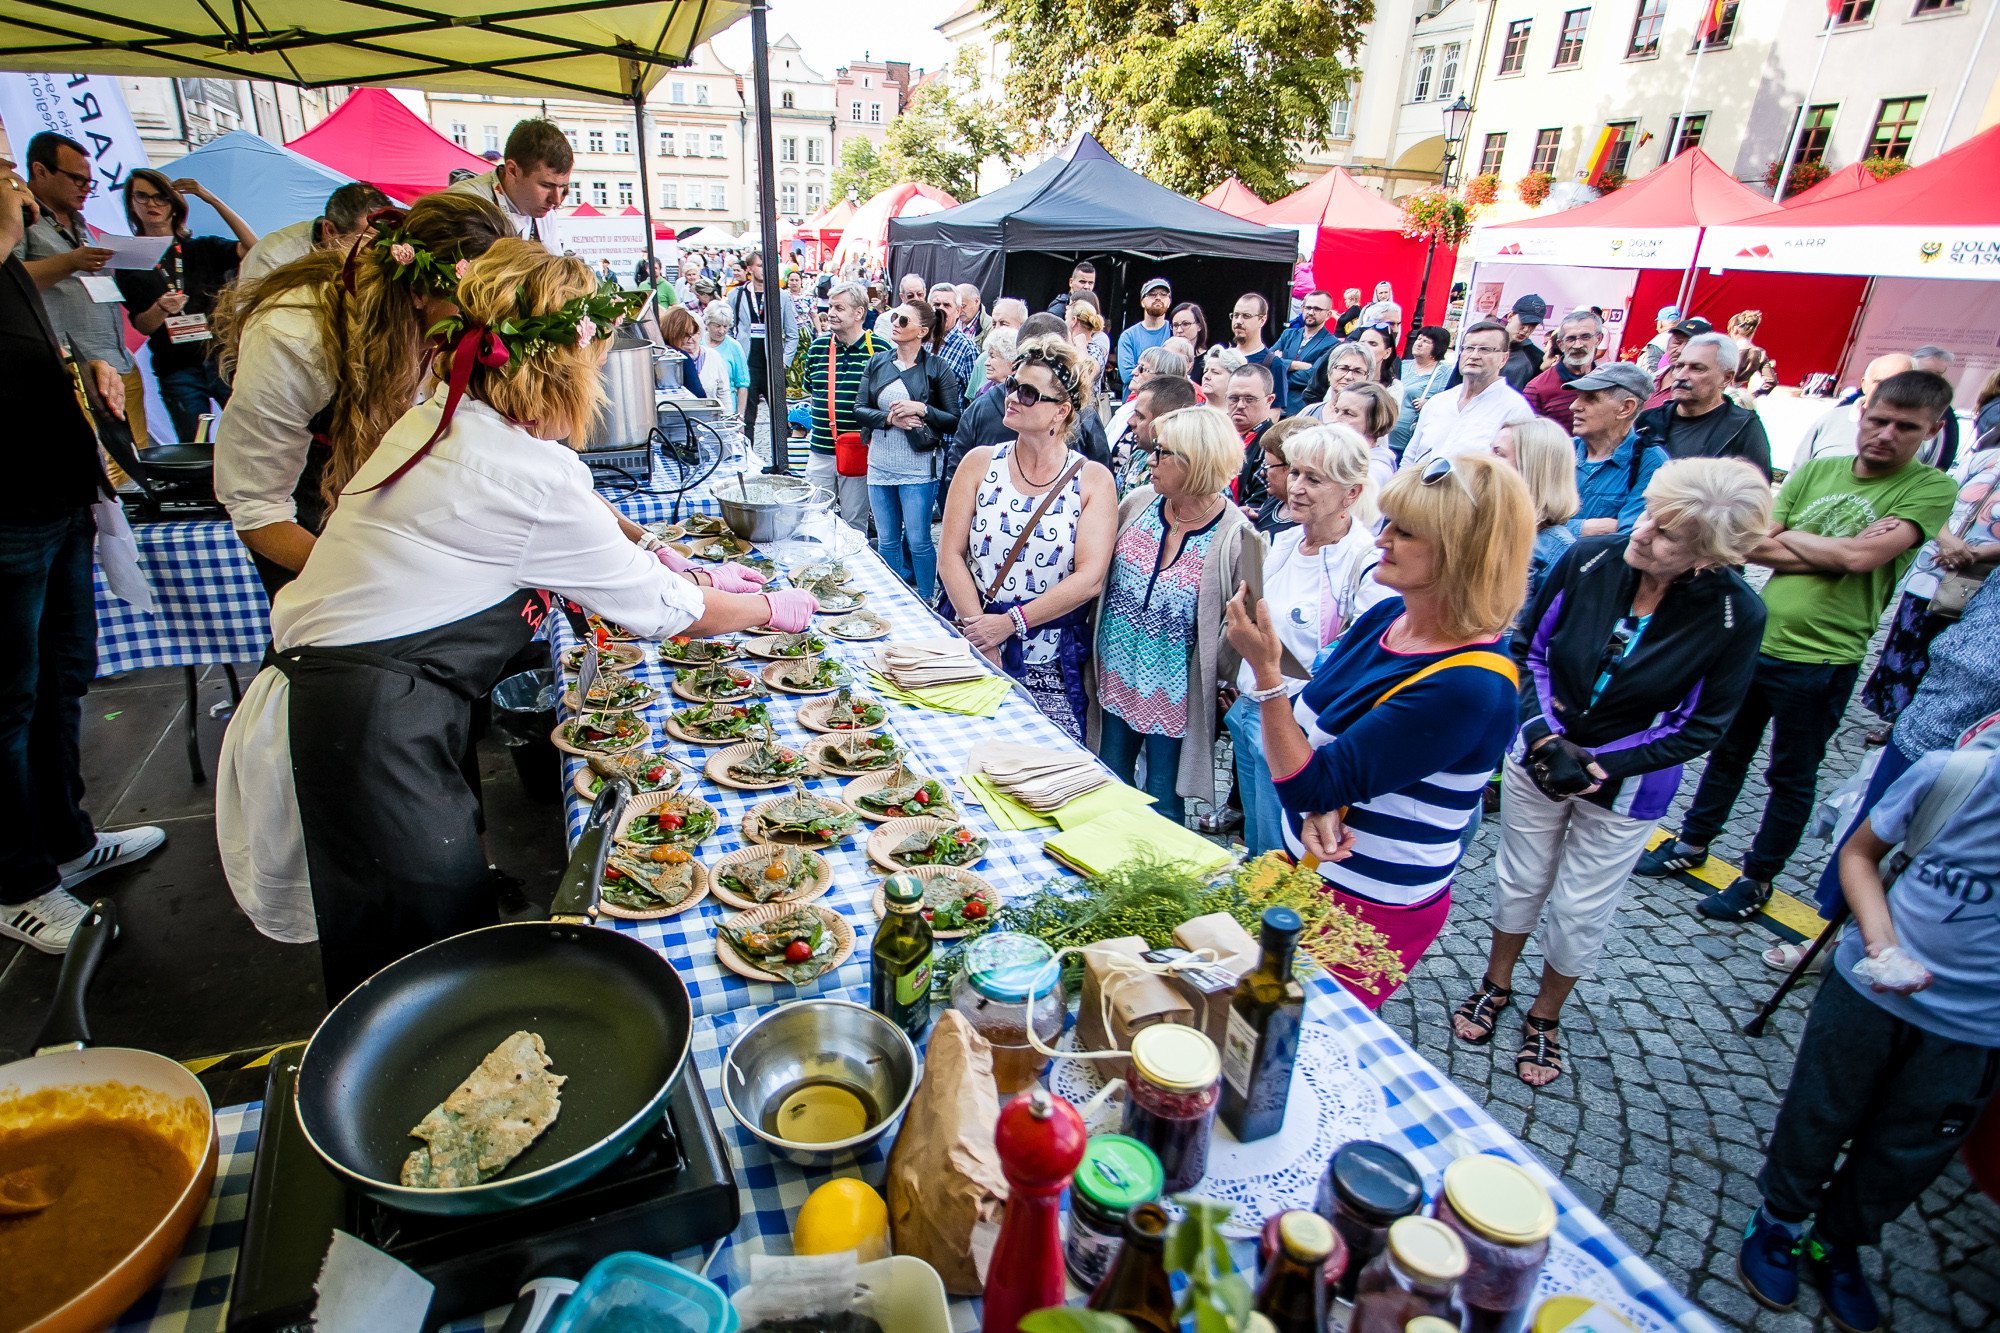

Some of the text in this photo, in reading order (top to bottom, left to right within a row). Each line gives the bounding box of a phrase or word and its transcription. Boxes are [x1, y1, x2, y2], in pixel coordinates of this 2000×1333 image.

[1952, 241, 2000, 252] DOLN
[1846, 494, 1877, 523] OUTOO
[521, 598, 544, 634] KA
